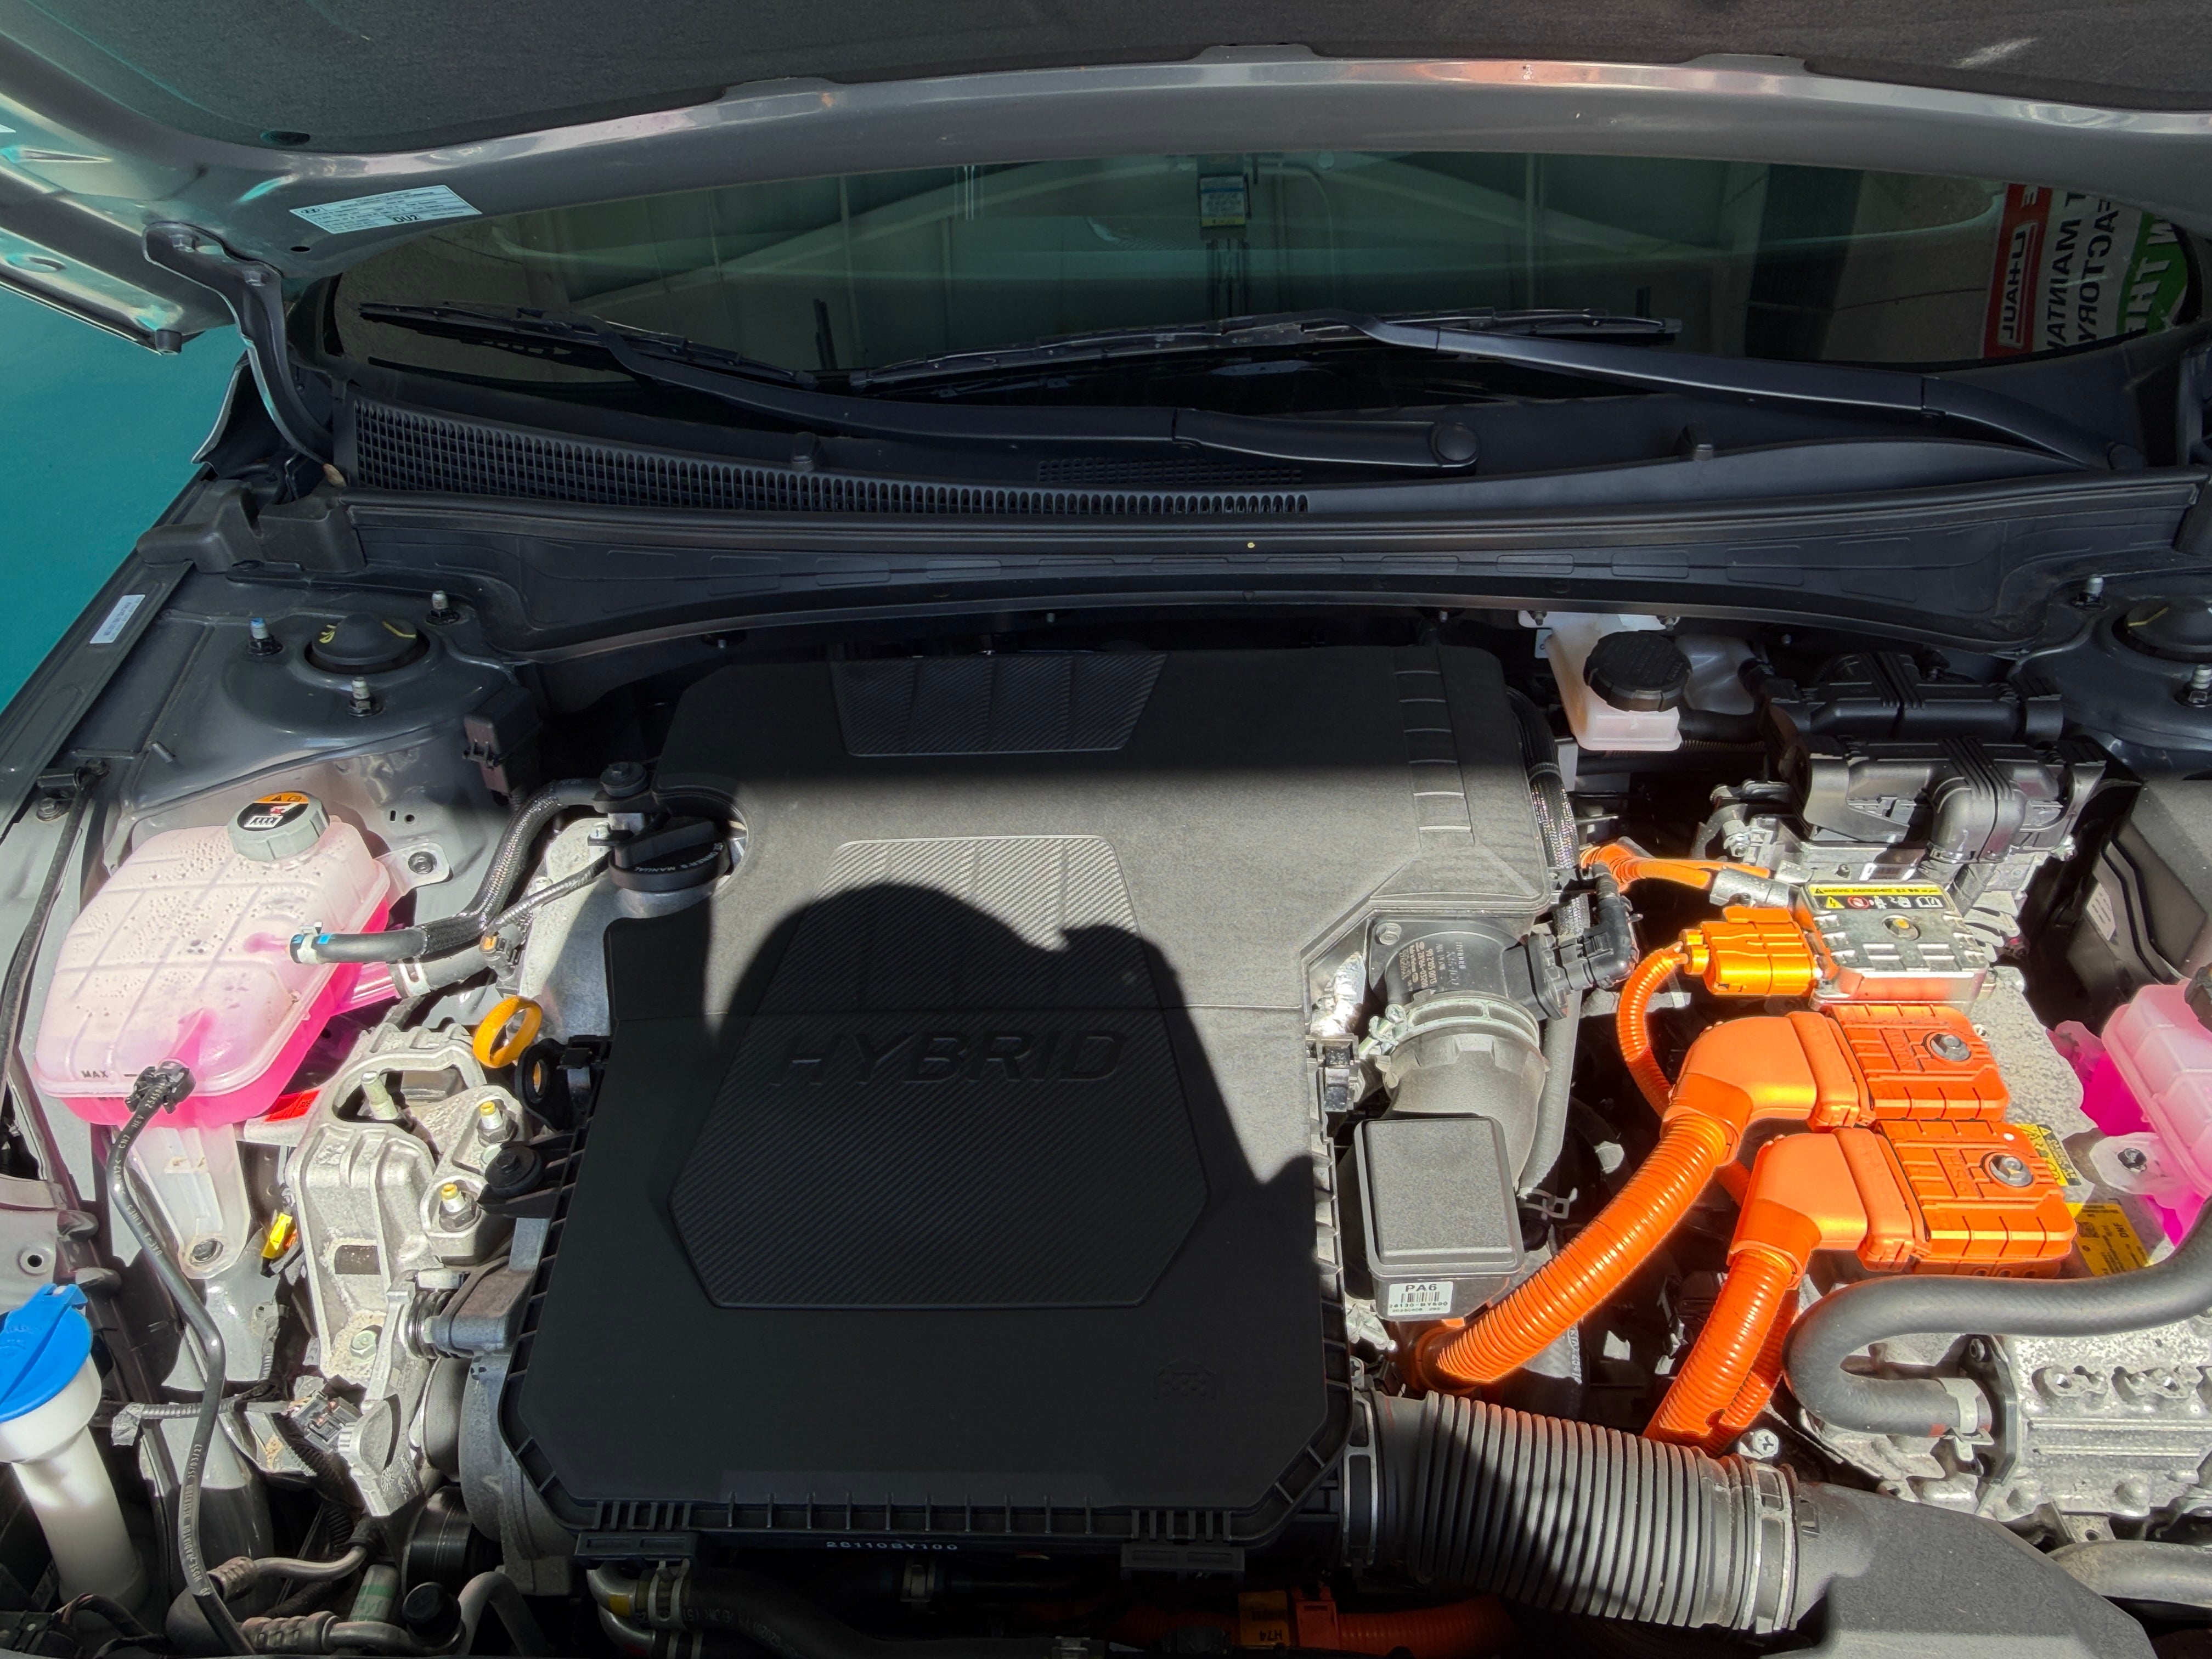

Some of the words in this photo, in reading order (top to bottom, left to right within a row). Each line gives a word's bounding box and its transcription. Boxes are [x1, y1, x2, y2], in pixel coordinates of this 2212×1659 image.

[770, 1030, 1127, 1086] HYBRID
[81, 1070, 109, 1079] MAX
[119, 1134, 131, 1149] CN7
[132, 1114, 144, 1128] HEV
[1940, 1151, 1972, 1193] HSG
[2112, 1222, 2130, 1238] DNF
[1405, 1284, 1437, 1292] PA6
[1259, 1629, 1283, 1641] H74
